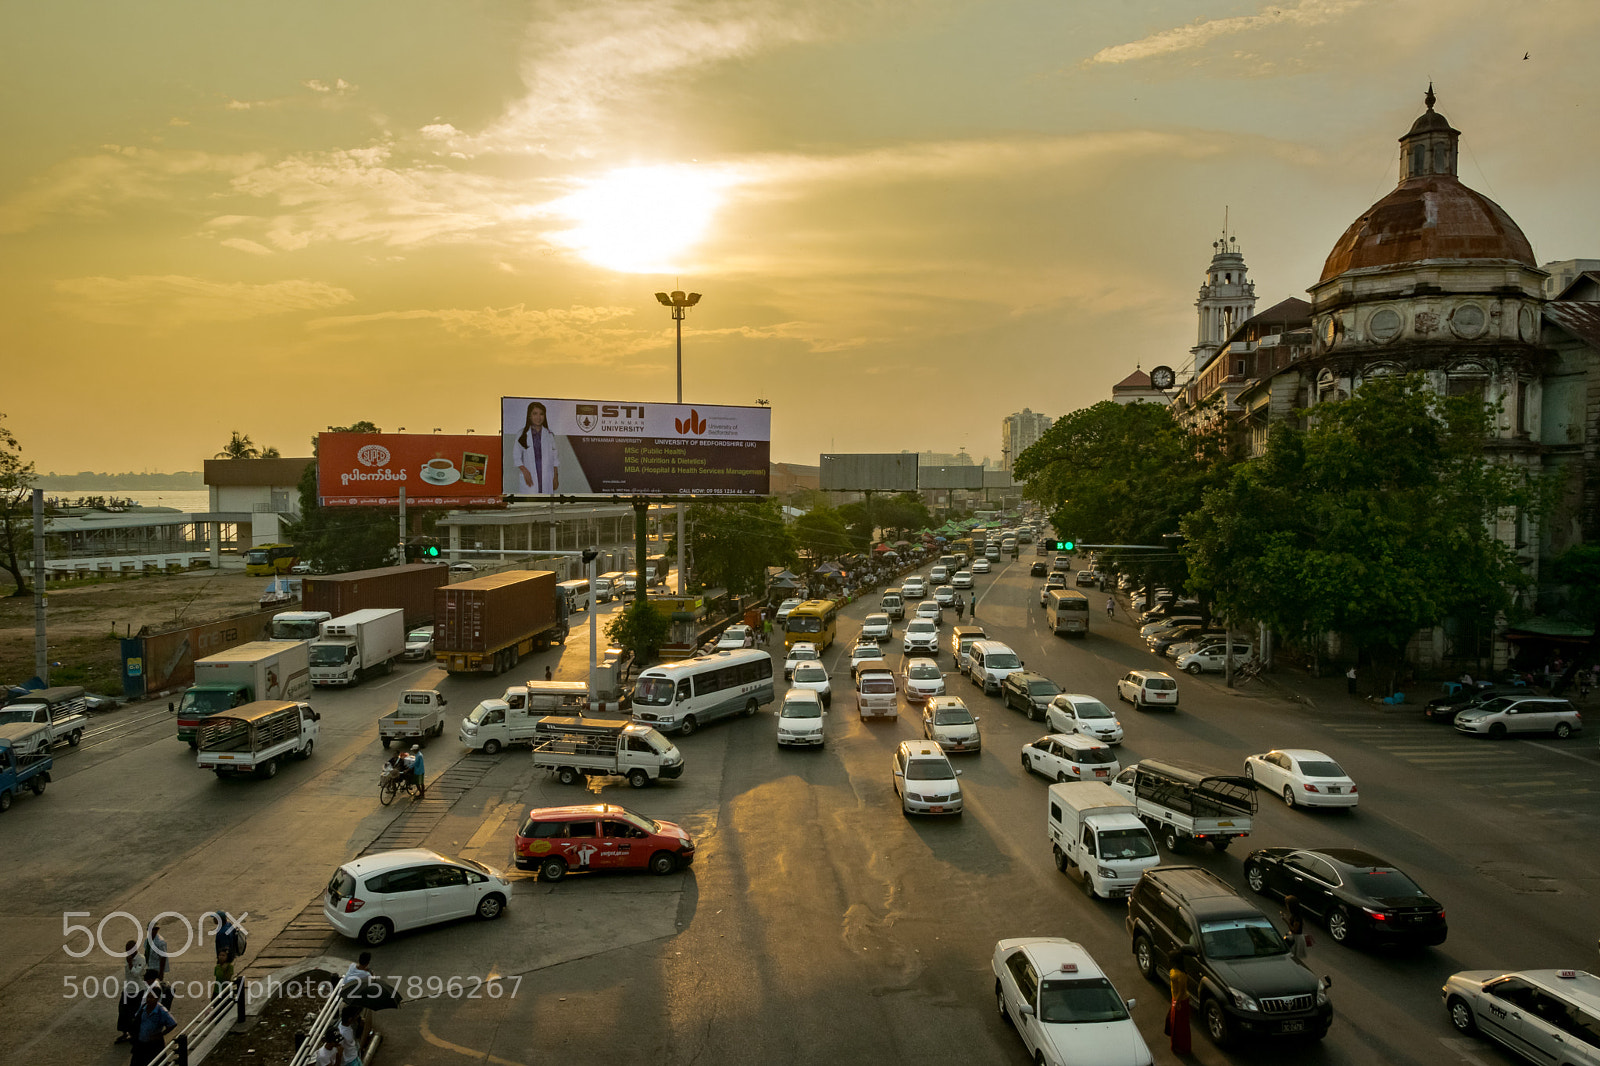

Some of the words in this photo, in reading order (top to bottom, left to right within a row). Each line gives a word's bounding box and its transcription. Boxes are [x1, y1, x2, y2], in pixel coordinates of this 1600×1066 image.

[602, 405, 644, 418] STI
[664, 448, 687, 456] Health)
[677, 458, 706, 466] Dietetics)
[641, 466, 670, 474] (Hospital
